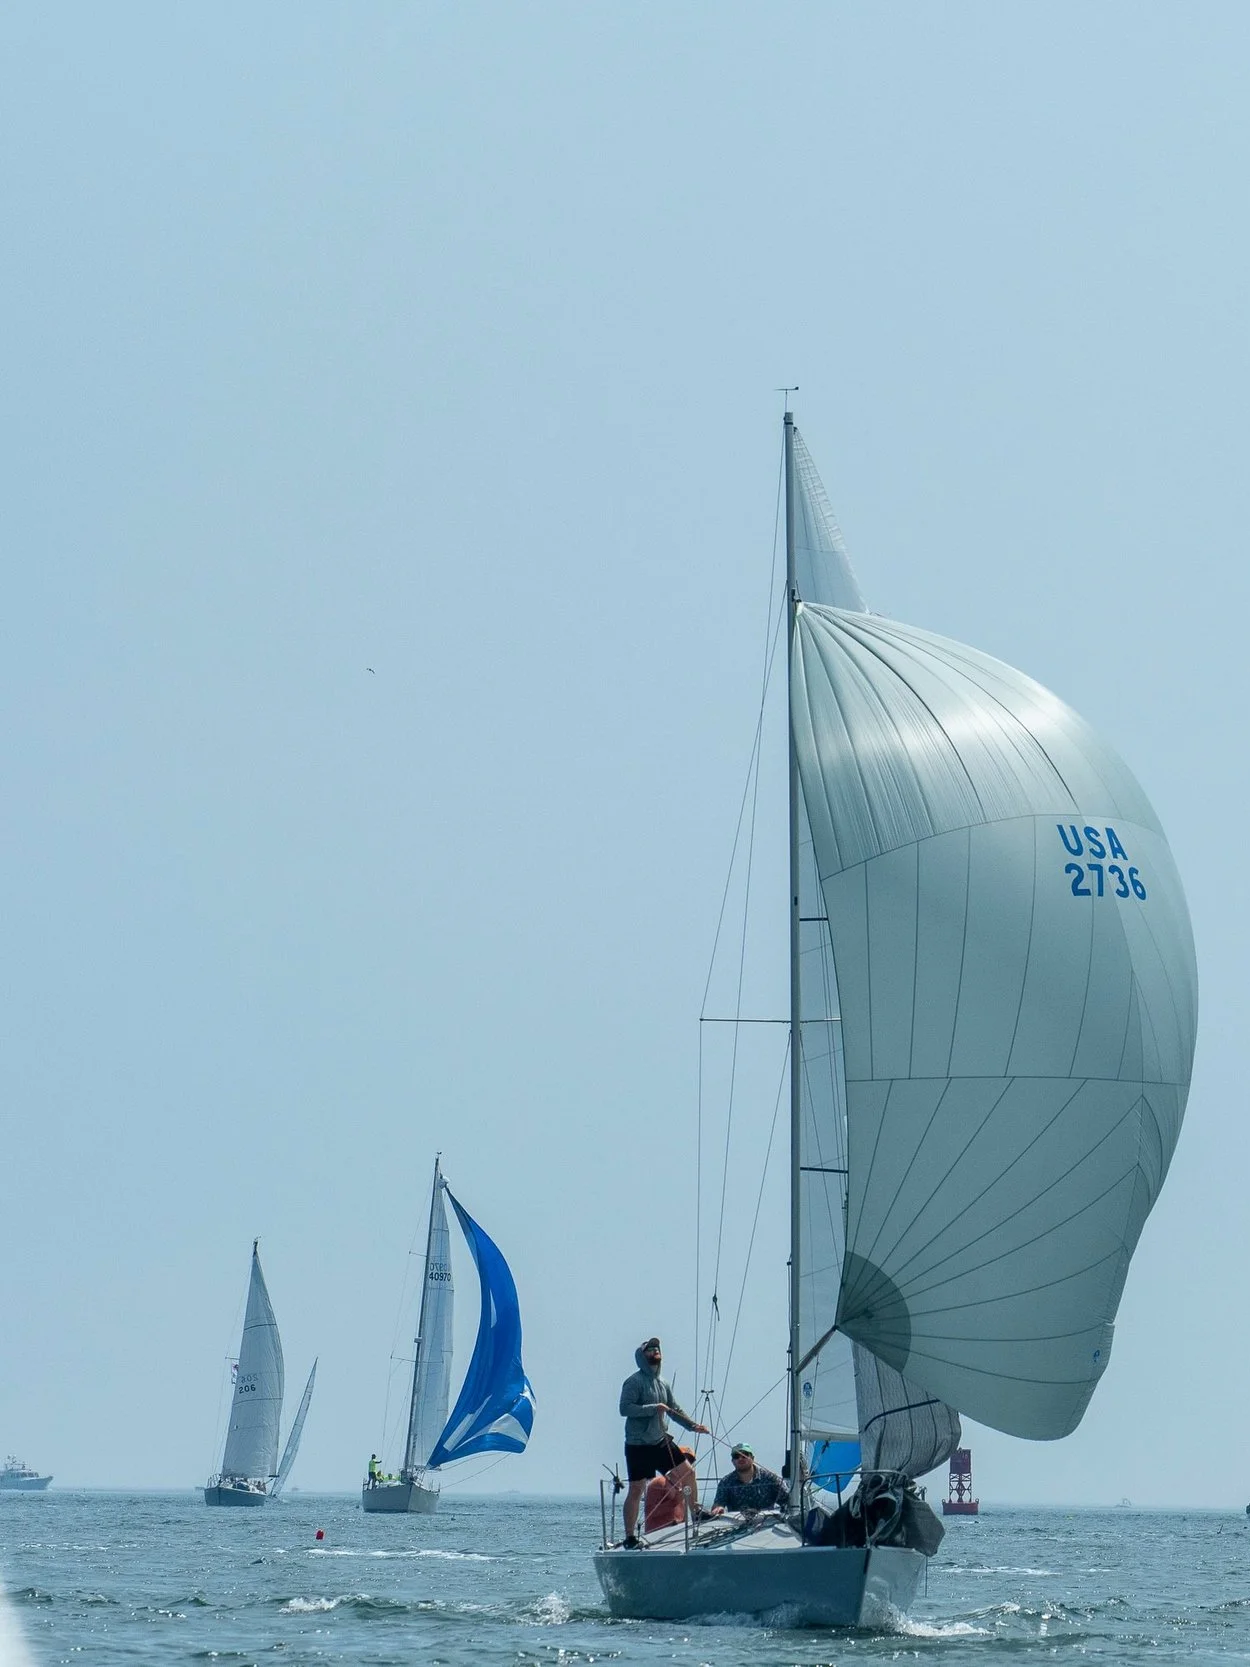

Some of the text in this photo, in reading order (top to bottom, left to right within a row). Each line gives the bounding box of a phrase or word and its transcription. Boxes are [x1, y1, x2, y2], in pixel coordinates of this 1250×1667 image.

[1056, 824, 1128, 861] USA
[1064, 862, 1146, 900] 2736
[429, 1271, 452, 1282] 40970
[238, 1383, 256, 1394] 206
